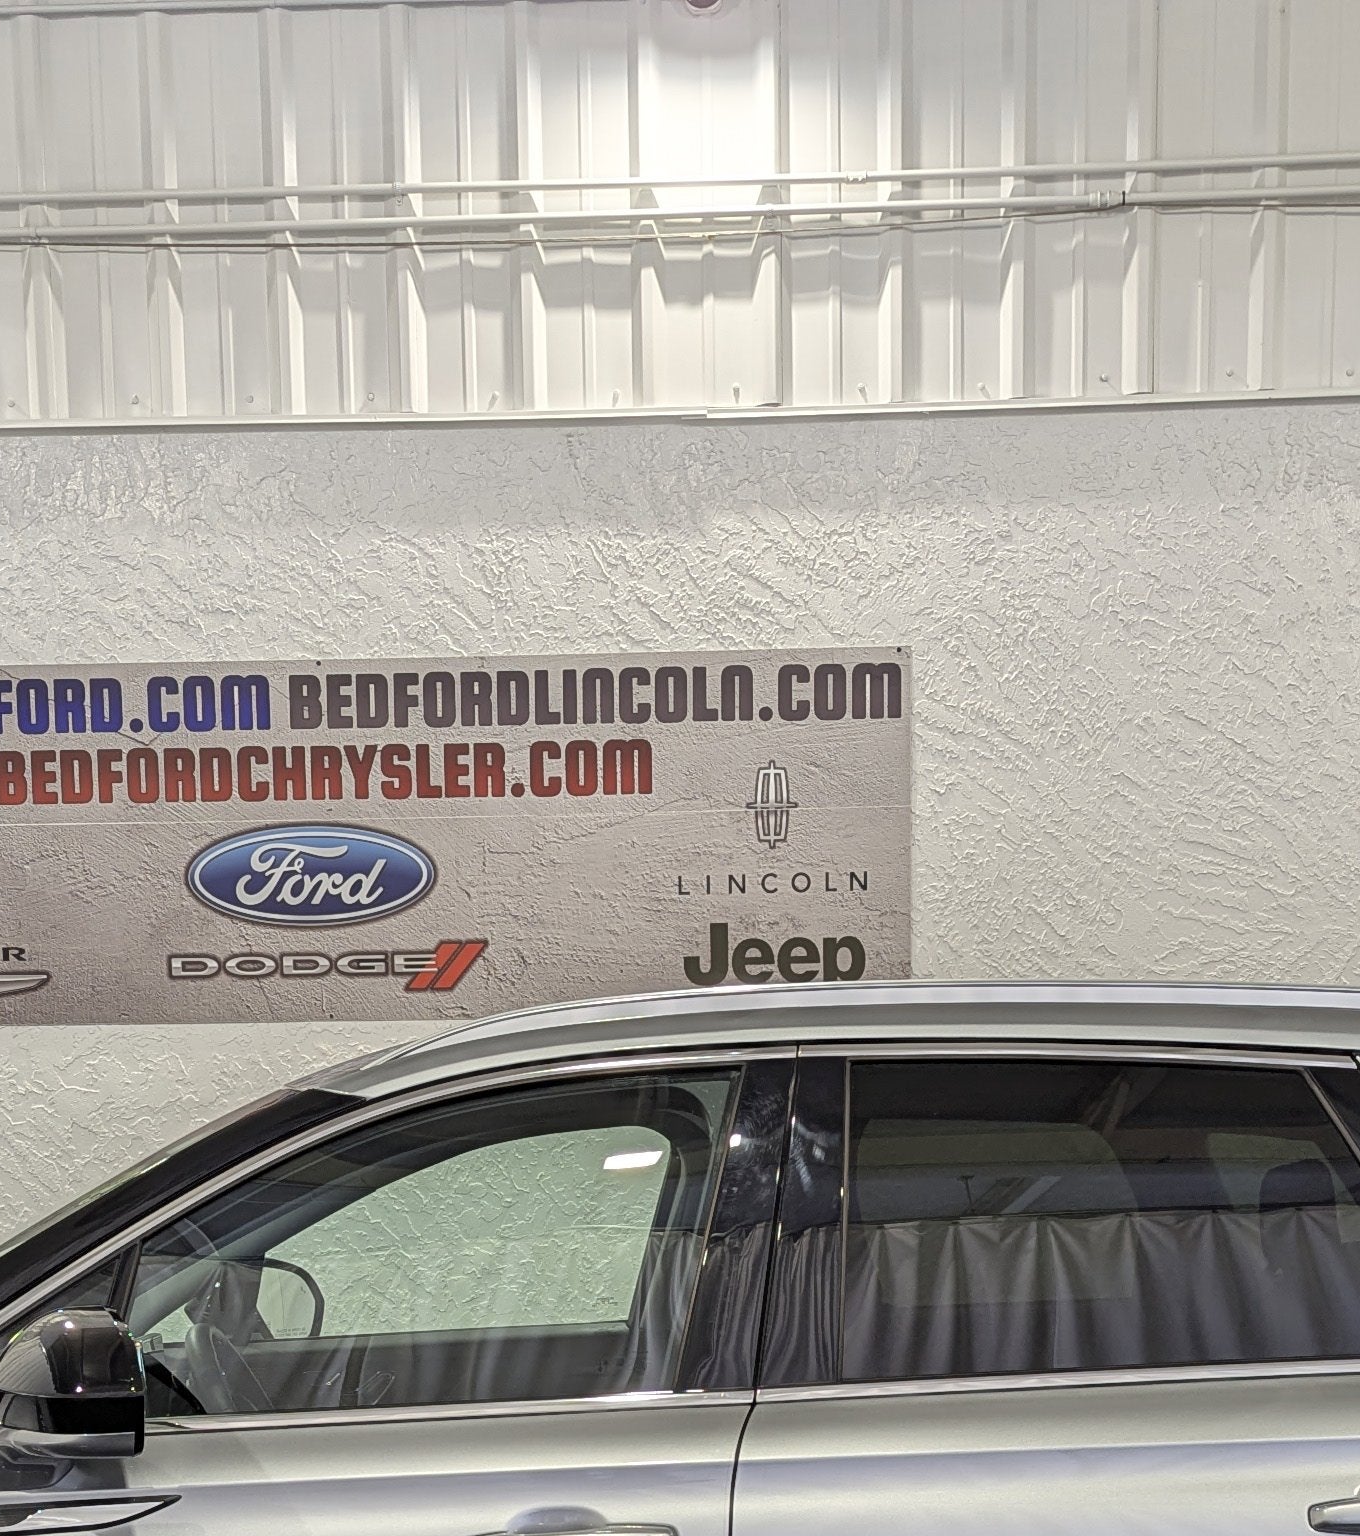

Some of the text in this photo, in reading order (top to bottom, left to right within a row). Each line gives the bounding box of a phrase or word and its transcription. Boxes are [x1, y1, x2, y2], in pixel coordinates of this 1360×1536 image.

[288, 662, 902, 730] BEDFORDLINCOLN.COM
[235, 843, 388, 905] Ford
[677, 870, 868, 896] LINCOLN
[169, 952, 439, 979] DODGE
[683, 922, 866, 986] Jeep
